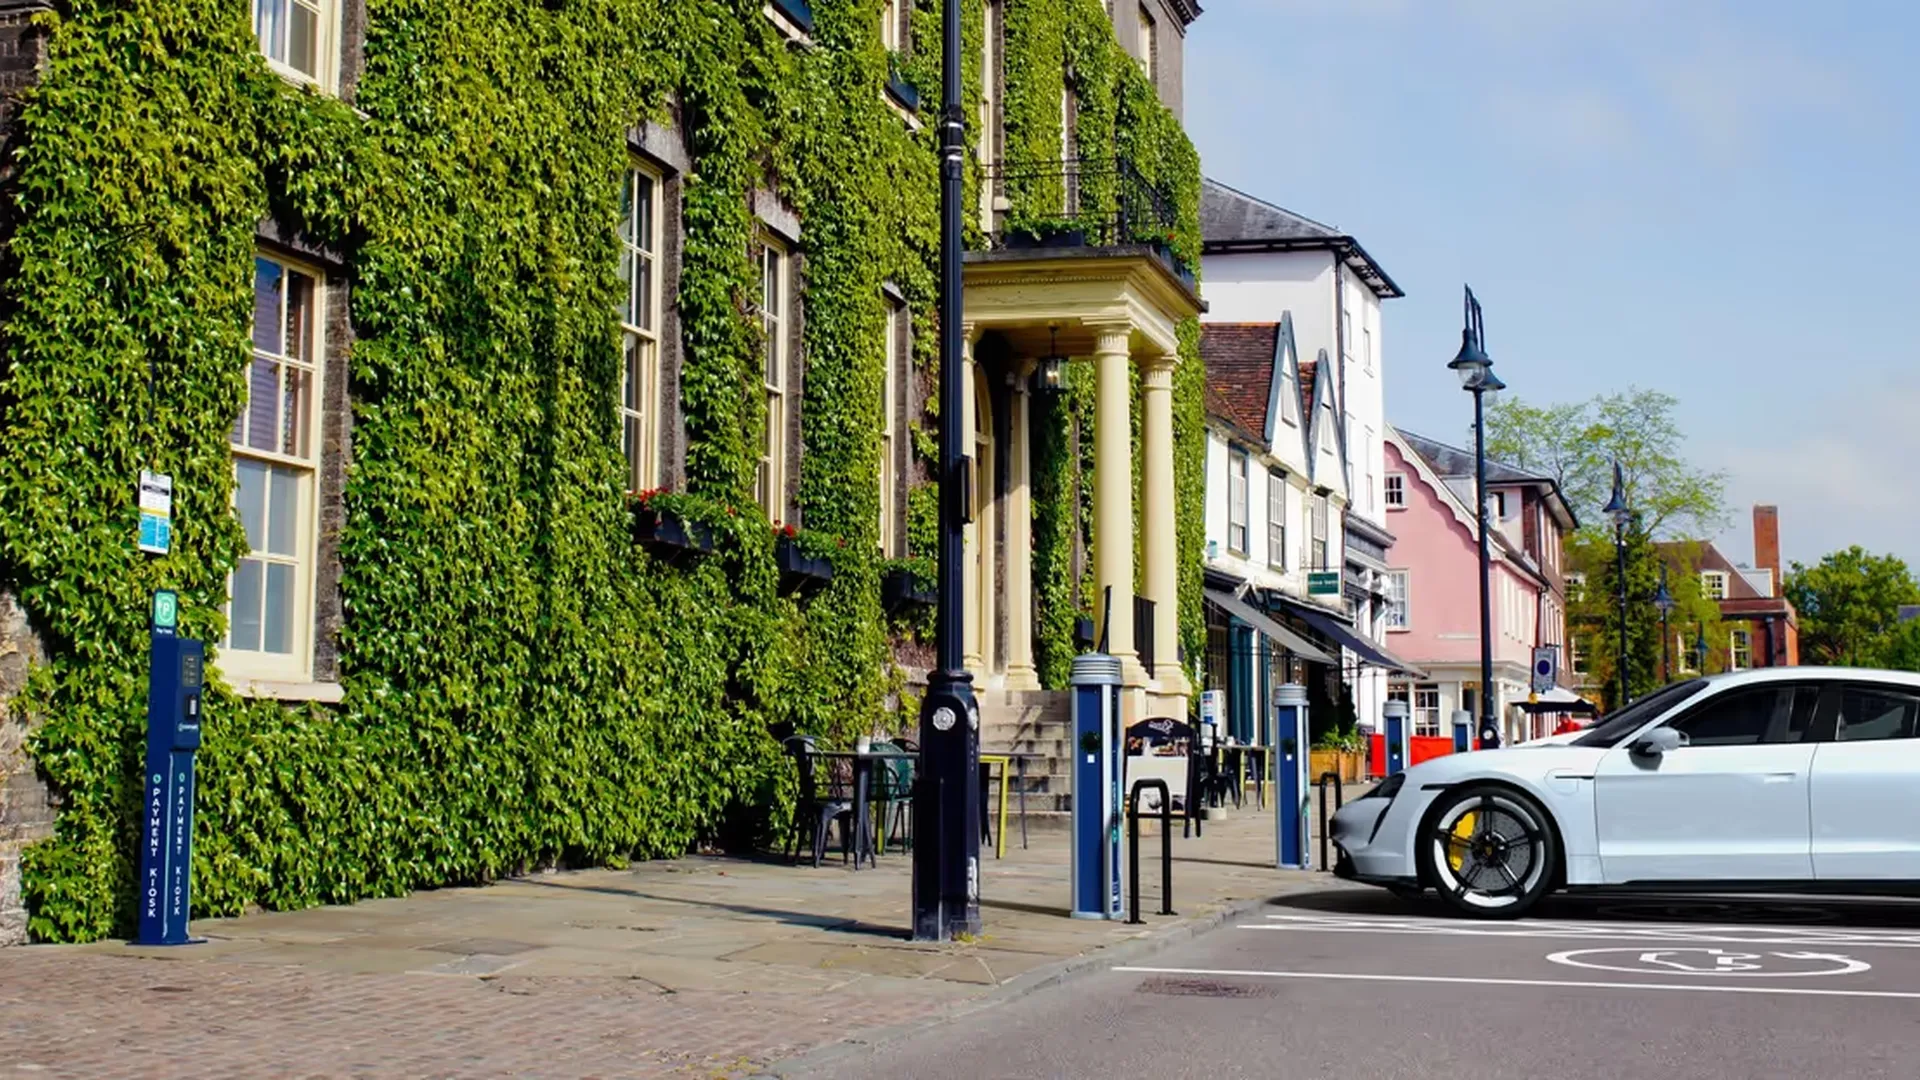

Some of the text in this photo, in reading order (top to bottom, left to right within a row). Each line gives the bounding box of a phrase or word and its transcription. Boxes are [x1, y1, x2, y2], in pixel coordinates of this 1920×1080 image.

[147, 787, 161, 918] PAYMENT KIOSK
[173, 786, 185, 916] PAYMENT KIOSK
